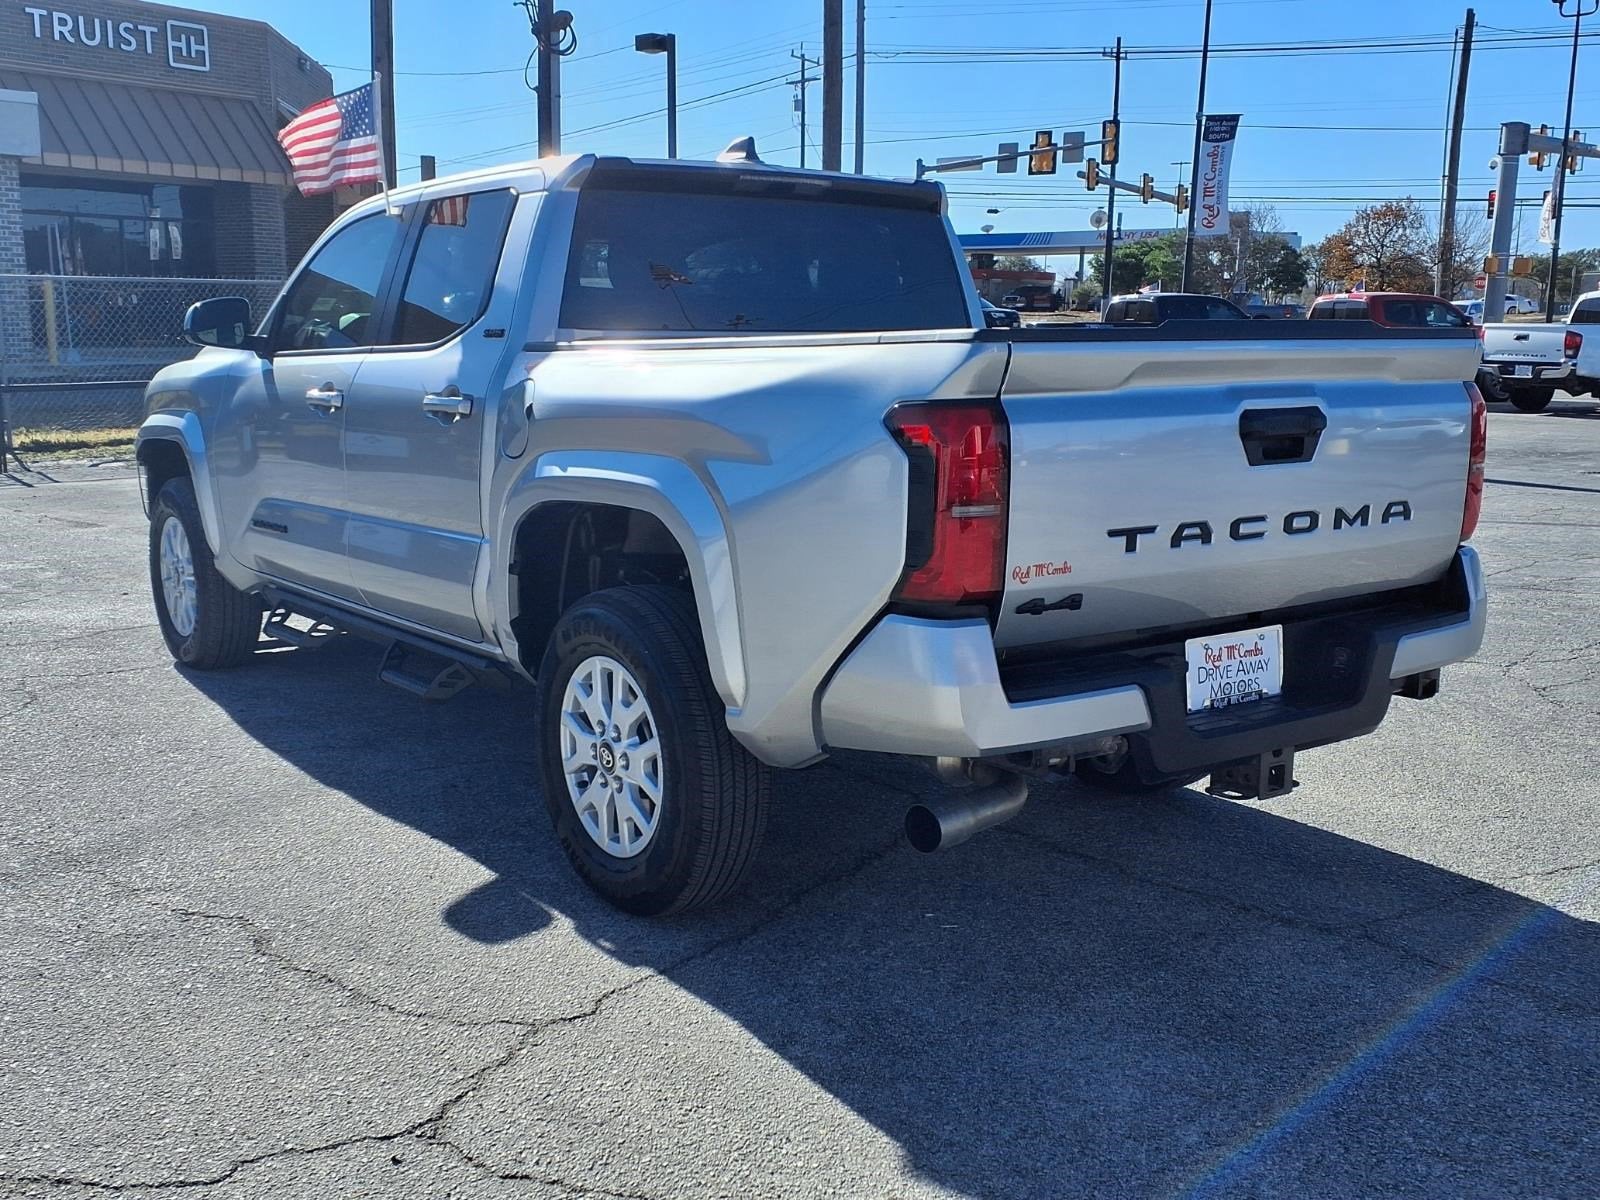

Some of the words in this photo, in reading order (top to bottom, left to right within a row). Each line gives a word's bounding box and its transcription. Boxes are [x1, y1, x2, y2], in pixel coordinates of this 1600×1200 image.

[25, 7, 158, 54] TRUIST
[1203, 145, 1220, 201] McCombs
[1201, 204, 1221, 229] Red
[1140, 230, 1160, 239] USA
[1106, 500, 1413, 553] TACOMA
[1012, 565, 1031, 585] Red
[1032, 560, 1072, 577] McCombs
[1204, 647, 1223, 669] Red
[1224, 641, 1264, 661] McCombs
[1197, 664, 1233, 685] DRIVE
[1235, 657, 1271, 678] AWAY
[1210, 678, 1260, 698] MOTORS
